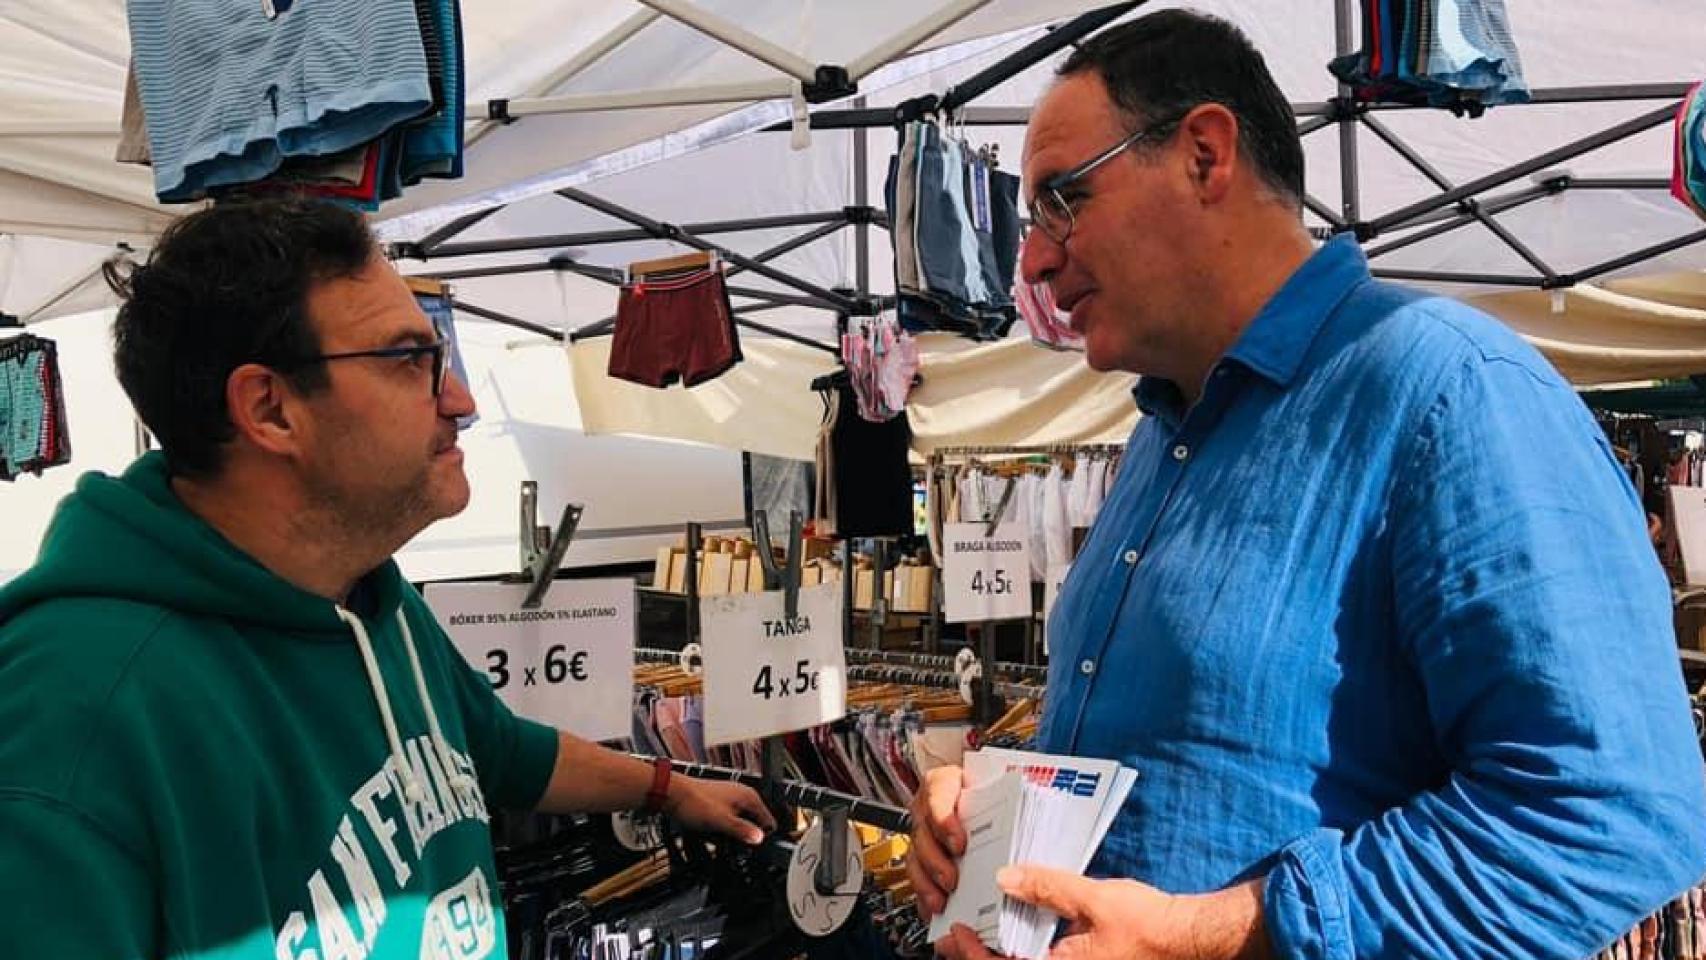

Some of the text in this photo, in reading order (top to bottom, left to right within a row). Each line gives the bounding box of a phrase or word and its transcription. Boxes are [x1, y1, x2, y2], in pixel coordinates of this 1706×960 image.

[954, 541, 983, 552] BRAGA
[510, 610, 554, 622] ALGODÓN
[573, 607, 616, 618] ELASTANO
[762, 616, 811, 638] TANGA
